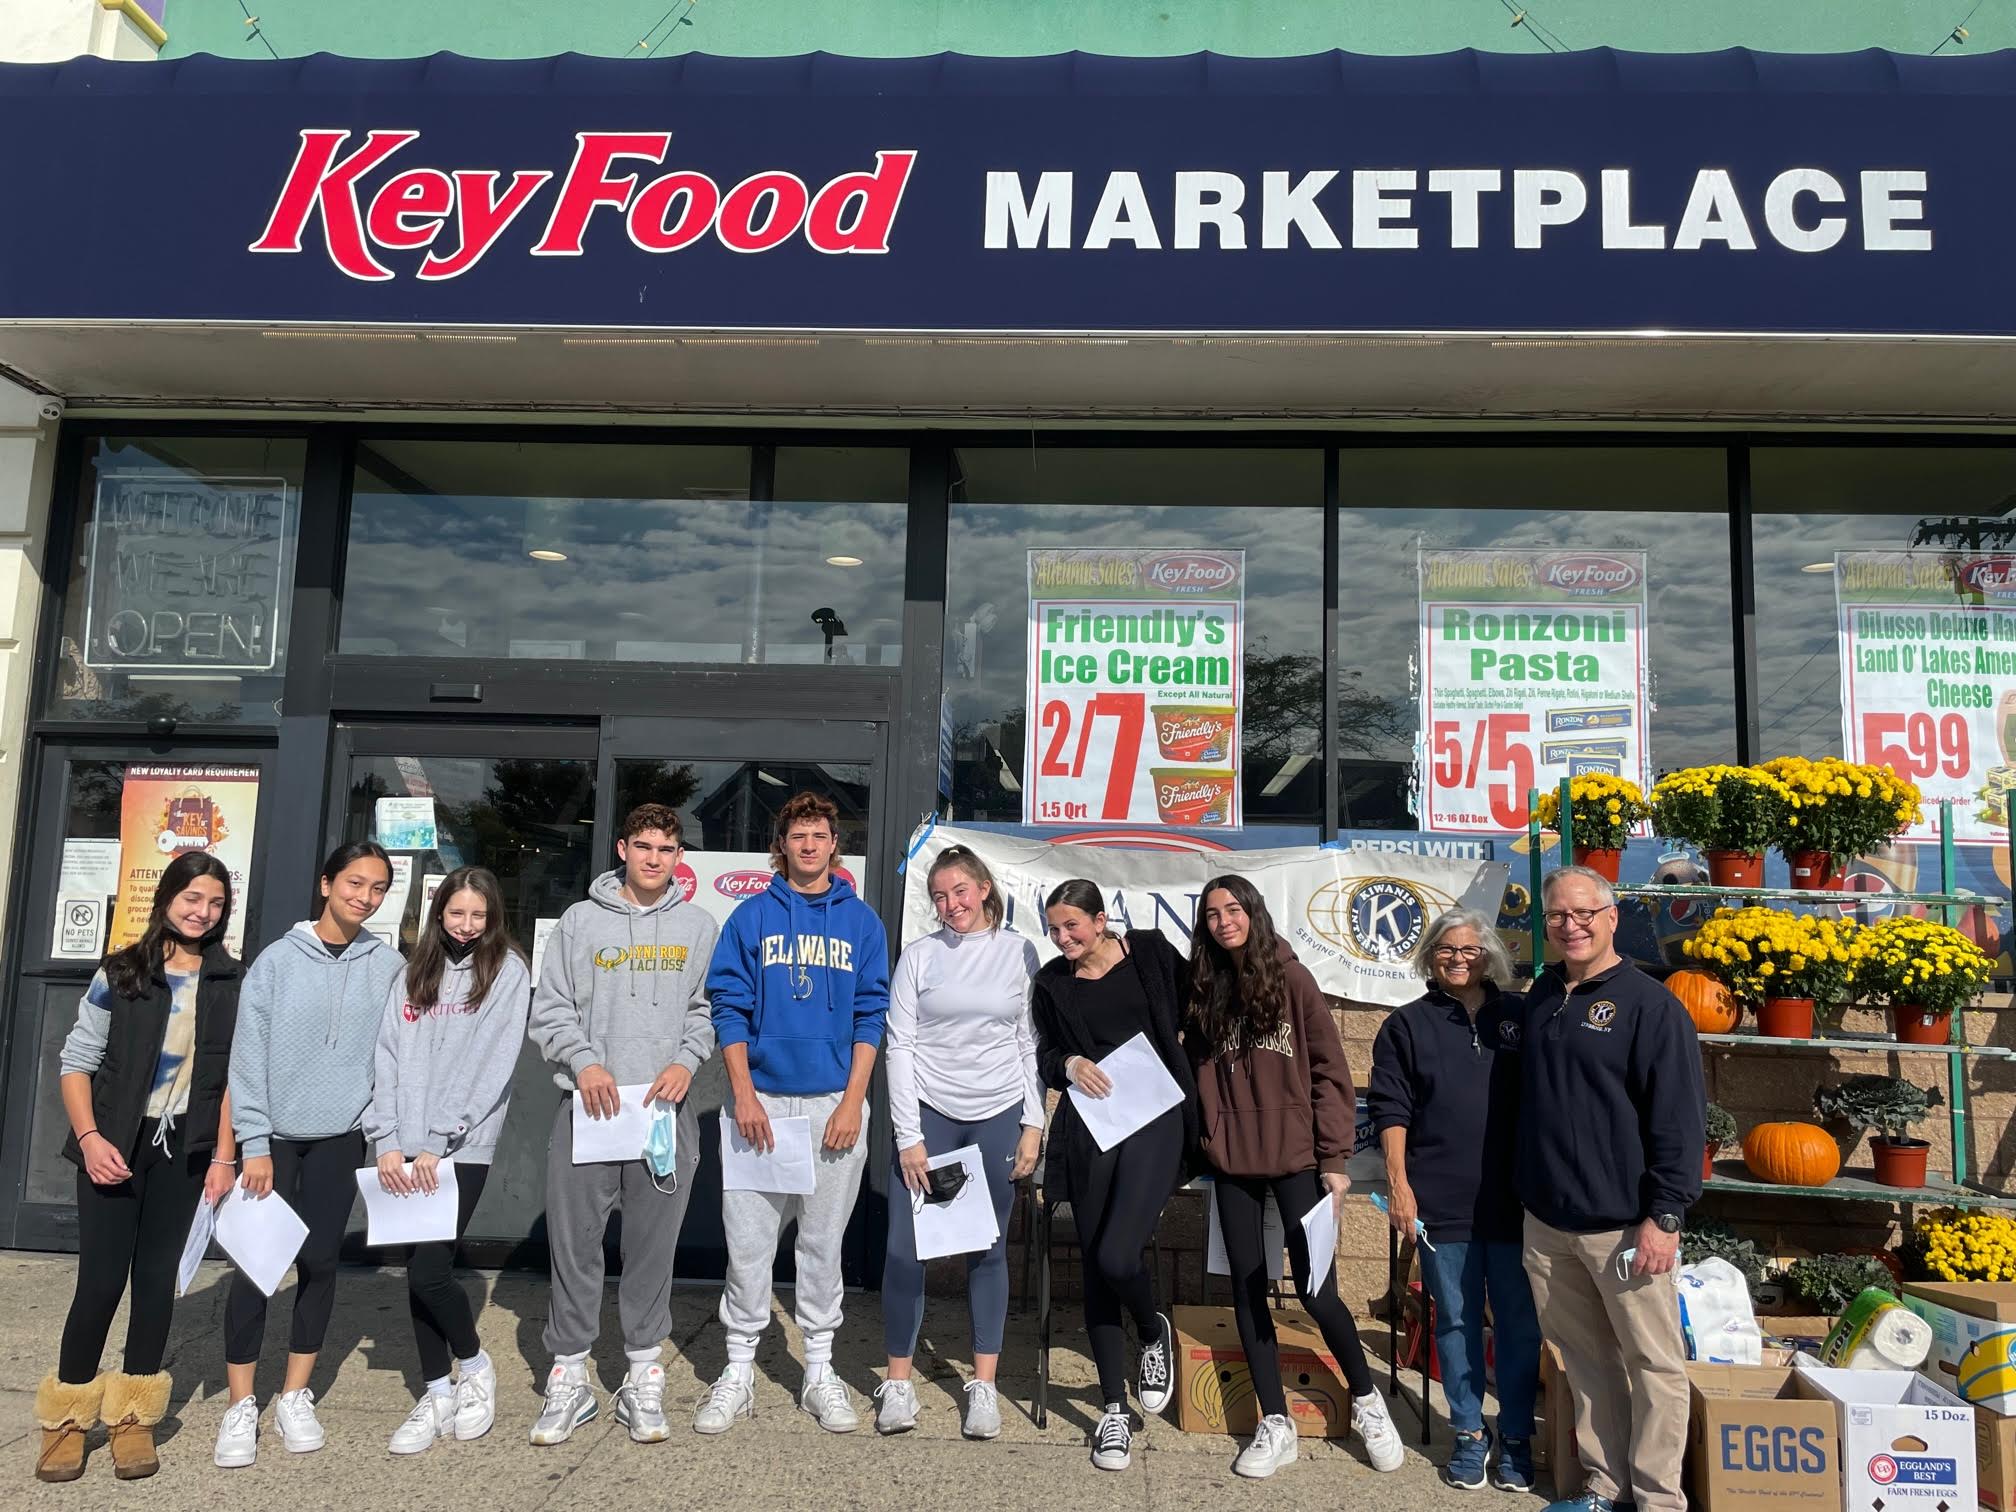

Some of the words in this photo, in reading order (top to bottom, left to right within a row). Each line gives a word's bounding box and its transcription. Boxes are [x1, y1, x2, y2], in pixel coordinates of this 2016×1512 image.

[249, 129, 553, 281] Key
[530, 131, 917, 256] Food
[984, 167, 1932, 253] MARKETPLACE
[1152, 562, 1184, 583] Key
[1183, 563, 1227, 580] Food
[1549, 565, 1579, 585] Key
[1583, 565, 1628, 582] Food
[1970, 567, 2004, 587] Key
[1997, 591, 2016, 599] FRES
[108, 610, 258, 656] OPEN
[1047, 609, 1225, 646] Friendly's
[1443, 608, 1626, 642] Ronzoni
[1857, 611, 1925, 640] DiLusso
[1930, 612, 1989, 641] Deluxe
[1041, 650, 1097, 684] Ice
[1107, 649, 1230, 685] Cream
[1470, 648, 1599, 682] Pasta
[1857, 645, 1898, 673] Land
[1902, 645, 1916, 673] O'
[1921, 645, 1971, 674] Lakes
[1157, 690, 1187, 699] Except
[1188, 690, 1200, 699] All
[1202, 690, 1232, 699] Natural
[1927, 679, 1992, 708] Cheese
[1160, 720, 1222, 745] Friendly's
[130, 766, 148, 776] NEW
[150, 767, 181, 776] LOYALTY
[183, 767, 203, 776] CARD
[1160, 784, 1221, 808] Friendly's
[1951, 797, 1970, 806] Order
[183, 813, 203, 826] KEY
[1041, 802, 1061, 818] 1.5
[1064, 802, 1087, 819] Qrt
[1434, 814, 1457, 823] 12-16
[1459, 815, 1470, 824] OZ
[1472, 815, 1488, 824] Box
[176, 825, 207, 836] SAVINGS
[130, 869, 163, 880] ATTENT
[720, 877, 745, 890] Key
[746, 878, 771, 890] Foo
[1360, 884, 1416, 906] KIWANIS
[1368, 895, 1403, 944] K
[78, 929, 94, 937] PETS
[1296, 927, 1335, 957] SERVING
[1338, 955, 1353, 970] THE
[1354, 965, 1406, 980] CHILDREN
[1925, 1410, 1938, 1420] 15
[1942, 1410, 1970, 1421] Doz.
[1720, 1423, 1826, 1474] EGGS
[1914, 1472, 1936, 1480] BEST
[1910, 1488, 1934, 1496] FRESH
